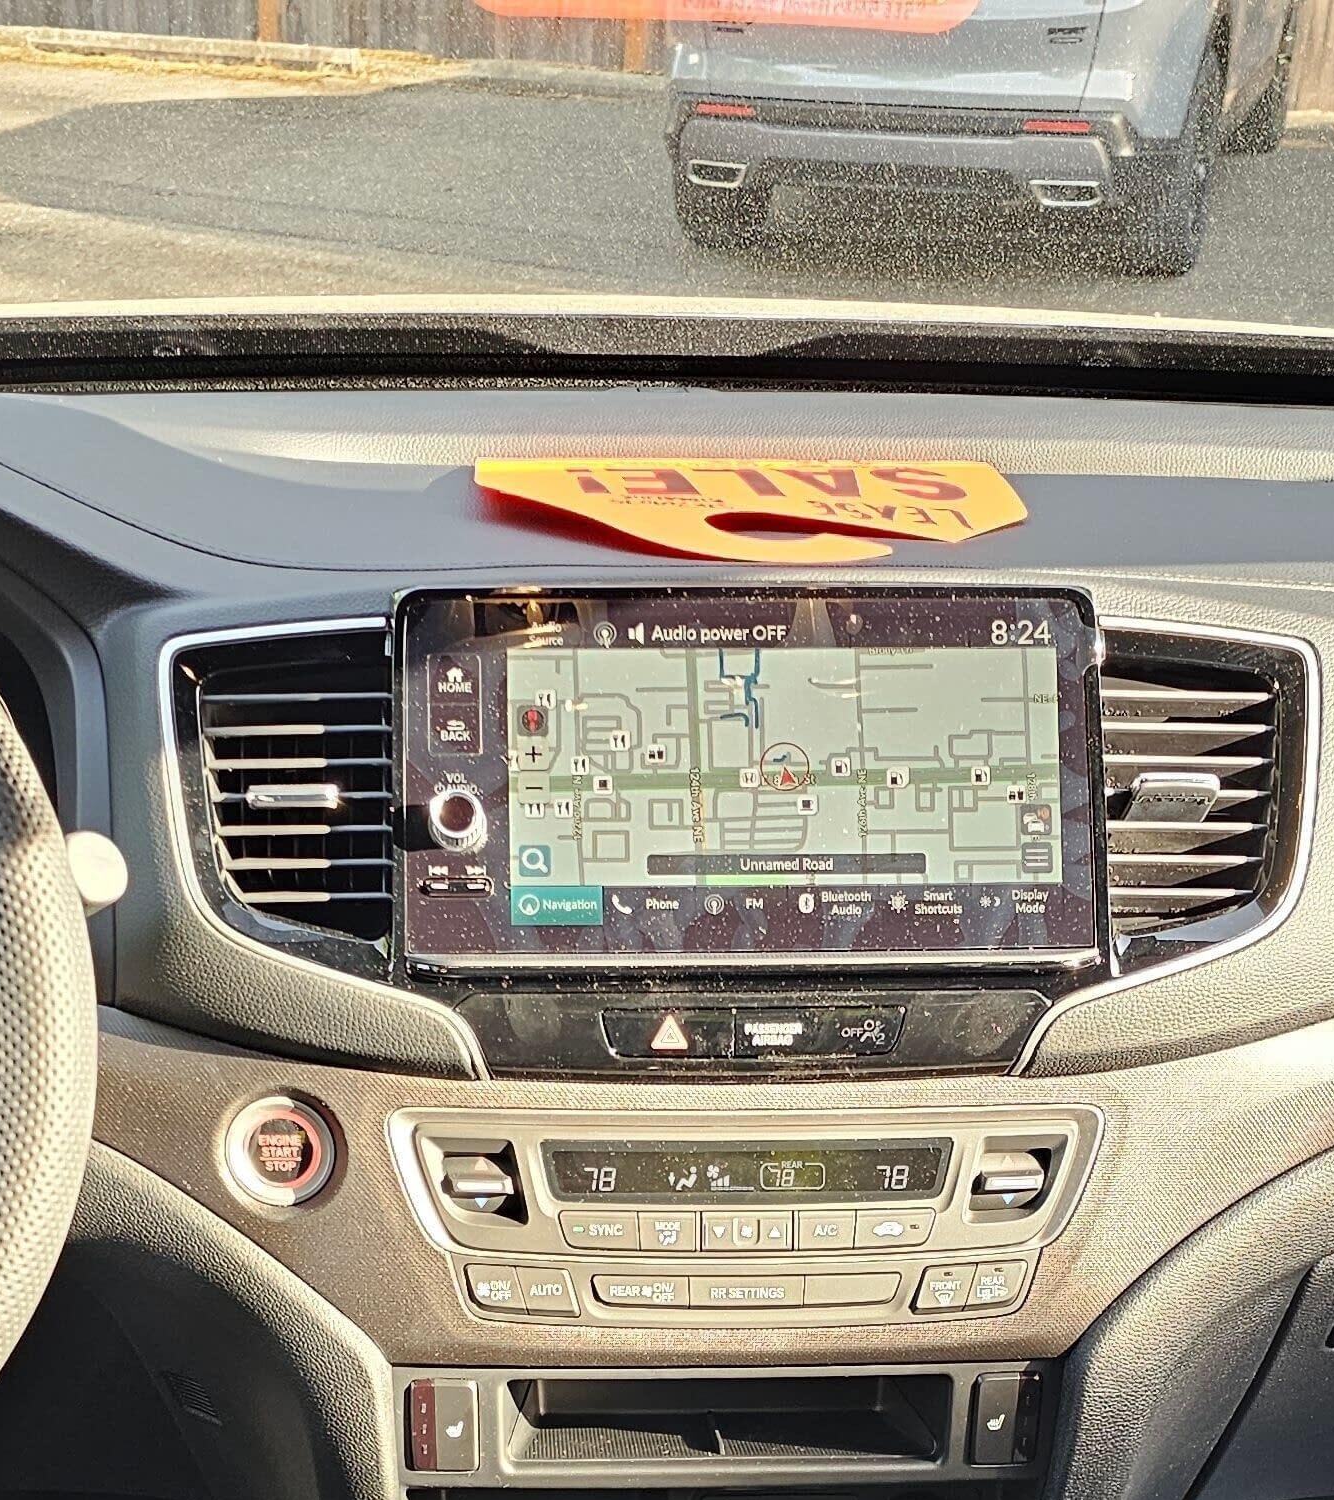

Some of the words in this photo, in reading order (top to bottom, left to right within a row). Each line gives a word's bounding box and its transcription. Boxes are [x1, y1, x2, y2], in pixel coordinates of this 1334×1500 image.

[565, 466, 968, 501] SALE!
[807, 500, 973, 530] LEASE
[651, 625, 697, 641] Audio
[701, 628, 750, 643] power
[752, 625, 787, 641] OFF
[990, 619, 1052, 645] 8:24
[438, 681, 472, 695] HOME
[440, 729, 471, 743] BACK
[446, 773, 468, 784] VOL
[689, 767, 701, 797] 124th
[857, 768, 867, 784] NE
[857, 785, 867, 807] Ave
[691, 800, 703, 823] Ave
[857, 809, 867, 838] 126th
[692, 826, 703, 842] NE
[740, 857, 801, 871] Unnamed
[803, 857, 834, 871] Road
[821, 890, 872, 903] Bluetooth
[923, 890, 953, 902] Smart
[1011, 890, 1049, 904] Display
[542, 898, 598, 912] Navigation
[645, 898, 680, 911] Phone
[745, 898, 764, 909] FM
[831, 903, 863, 916] Audio
[914, 903, 963, 915] Shortcuts
[1015, 902, 1046, 914] Mode
[841, 1027, 863, 1038] OFF
[258, 1134, 303, 1147] ENGINE
[261, 1147, 300, 1158] START
[265, 1161, 296, 1172] STOP
[780, 1160, 803, 1169] REAR
[583, 1167, 616, 1192] 78
[877, 1165, 910, 1190] 78
[588, 1223, 623, 1237] SYNC
[654, 1221, 681, 1232] MODE
[813, 1224, 838, 1237] A/C
[929, 1280, 962, 1291] FRONT
[980, 1276, 1005, 1286] REAR
[490, 1290, 511, 1300] OFF
[529, 1283, 563, 1296] AUTO
[609, 1285, 641, 1297] REAR
[710, 1287, 726, 1300] RR
[727, 1287, 785, 1300] SETTINGS
[653, 1292, 675, 1303] OFF
